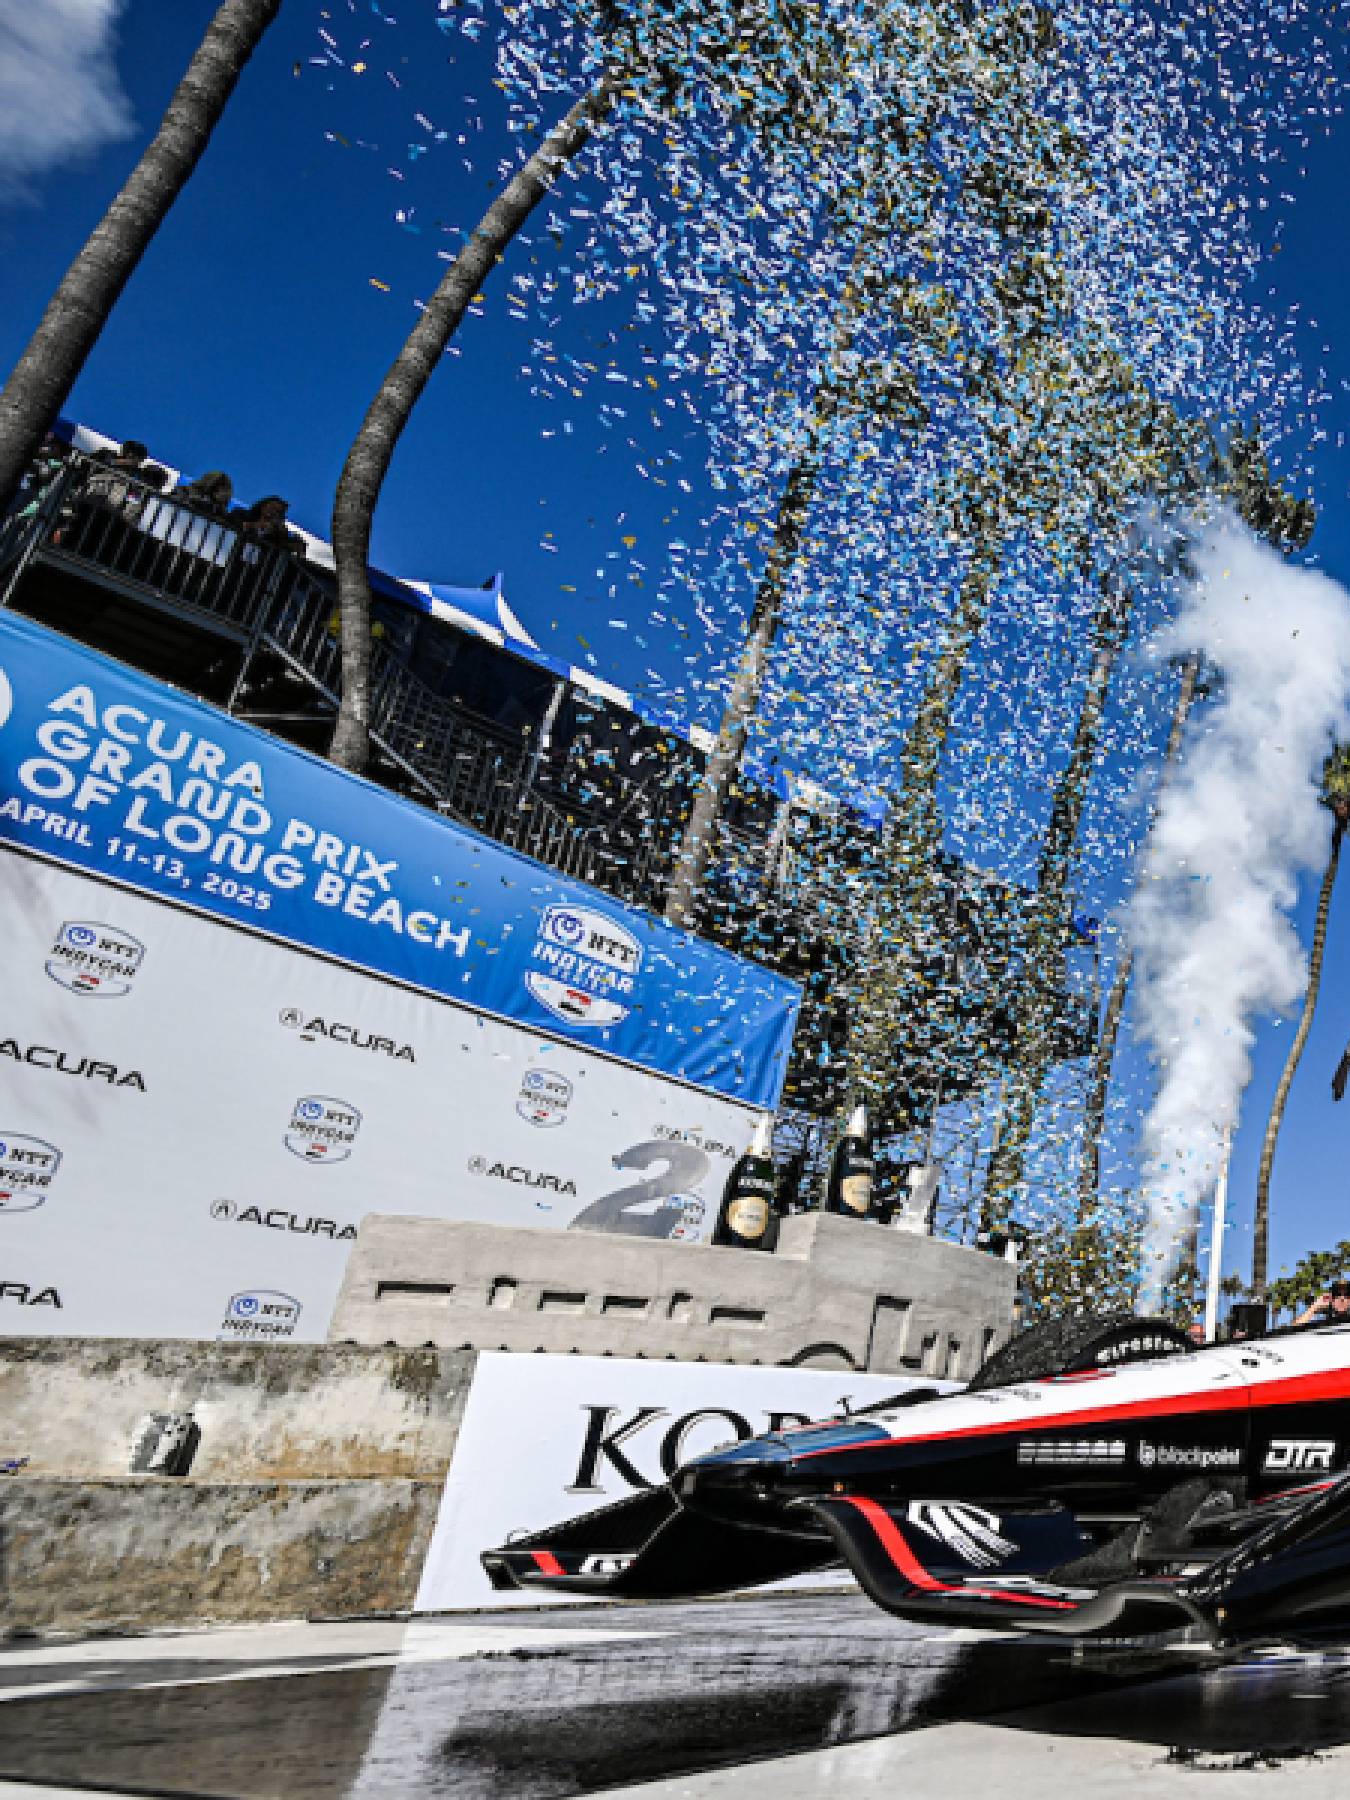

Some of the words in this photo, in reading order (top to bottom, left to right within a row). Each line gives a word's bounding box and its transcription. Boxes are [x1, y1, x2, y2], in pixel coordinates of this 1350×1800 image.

[48, 685, 264, 799] ACURA
[1, 797, 93, 848] APRIL
[107, 837, 191, 889] 11-13,
[203, 872, 271, 910] 2025
[37, 720, 271, 836] GRAND
[282, 818, 398, 892] PRIX
[18, 758, 120, 811] OF
[123, 797, 305, 889] LONG
[314, 870, 470, 957] BEACH
[0, 1038, 147, 1092] ACURA
[302, 1017, 417, 1064] ACURA
[236, 1205, 358, 1240] ACURA
[486, 1163, 577, 1197] ACURA
[567, 1139, 712, 1240] 2
